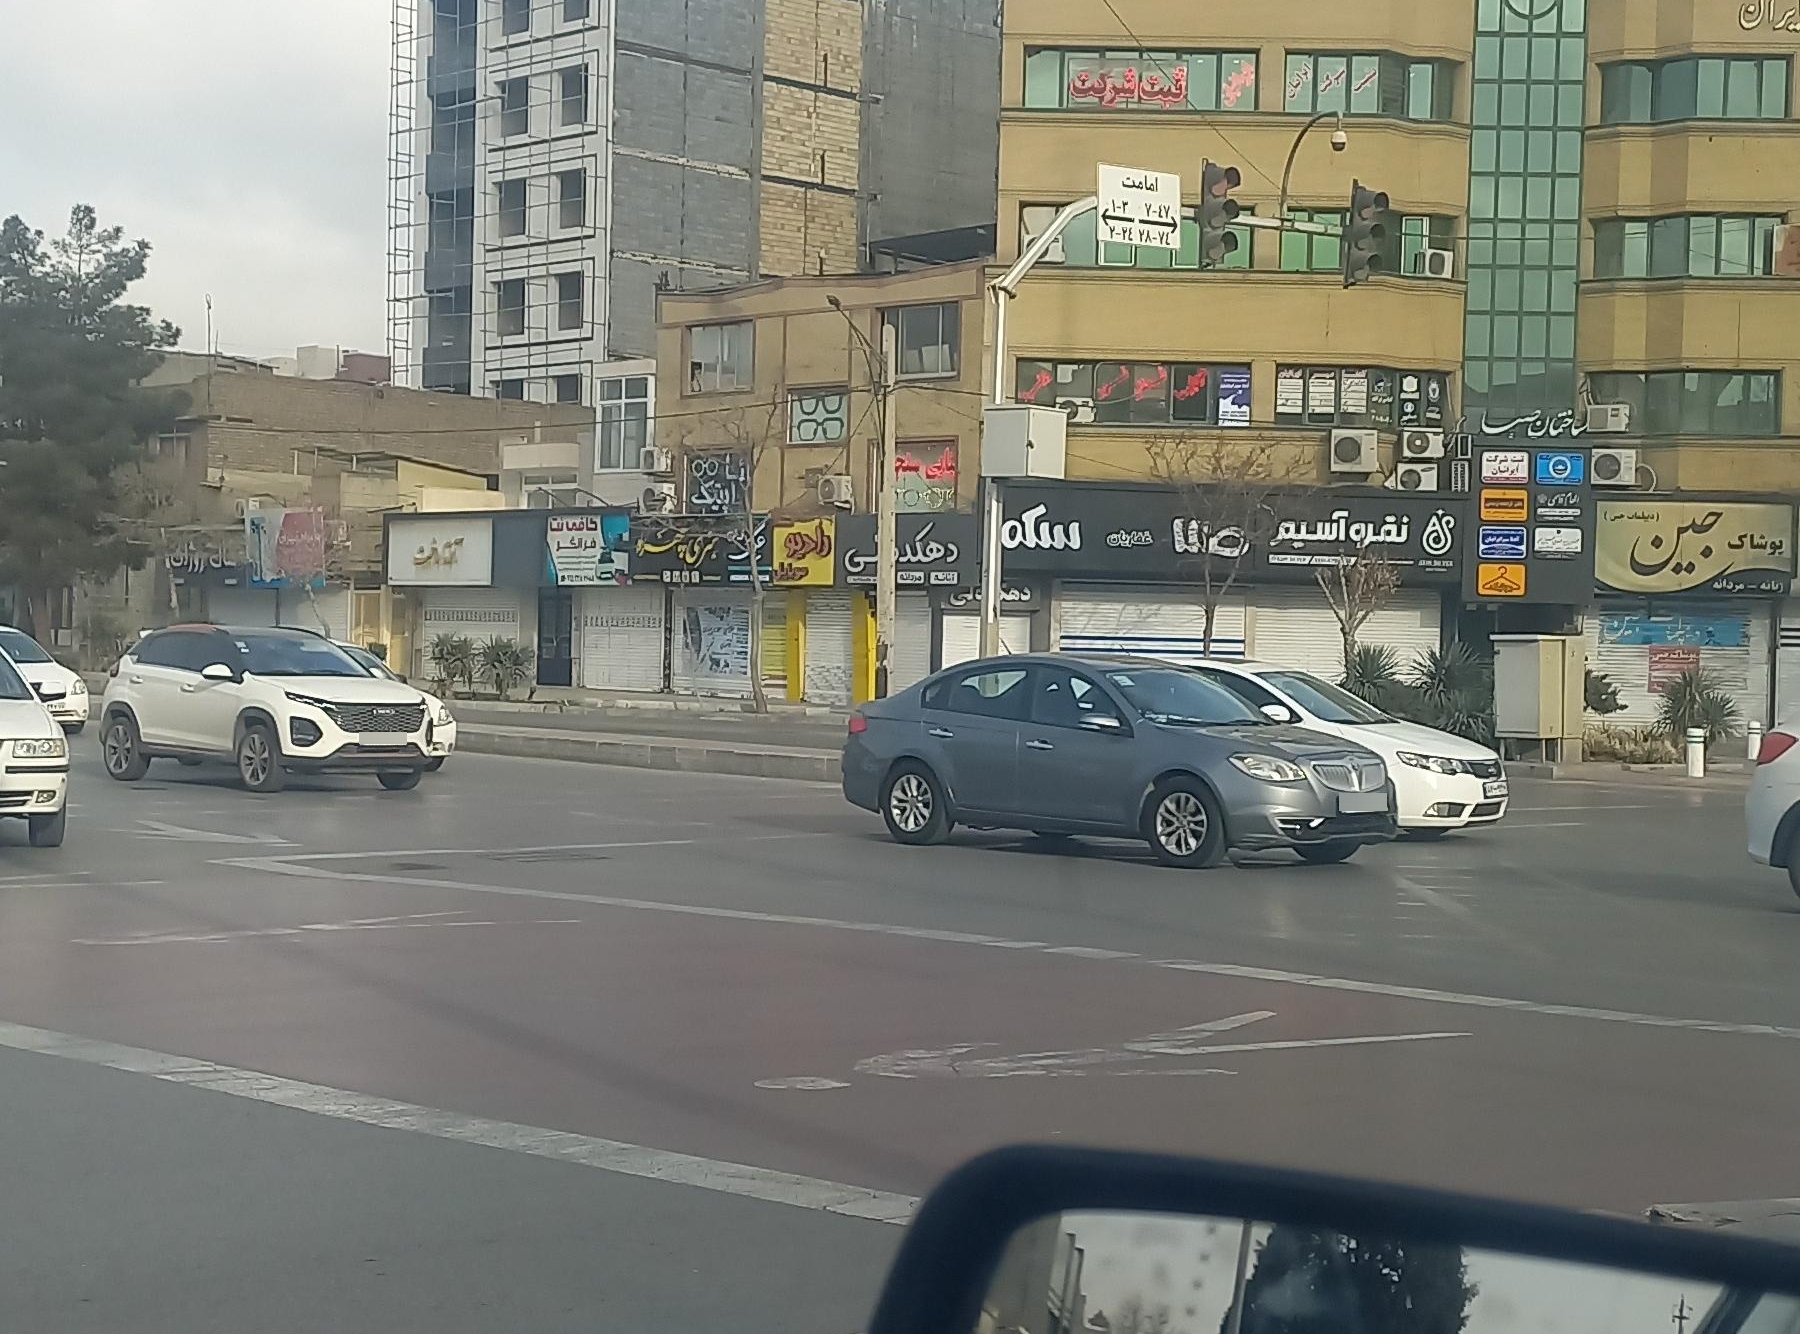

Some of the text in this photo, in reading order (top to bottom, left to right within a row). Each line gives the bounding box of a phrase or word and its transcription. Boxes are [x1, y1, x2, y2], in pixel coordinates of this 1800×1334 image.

[1069, 67, 1138, 108] شرکت
[1139, 66, 1187, 109] ثبت
[1122, 175, 1158, 192] امامت
[1486, 454, 1508, 465] شرکت
[784, 524, 832, 560] رادیو
[896, 521, 959, 563] دهکد
[1000, 503, 1081, 551] سکه
[1630, 510, 1784, 576] پوشاک جین
